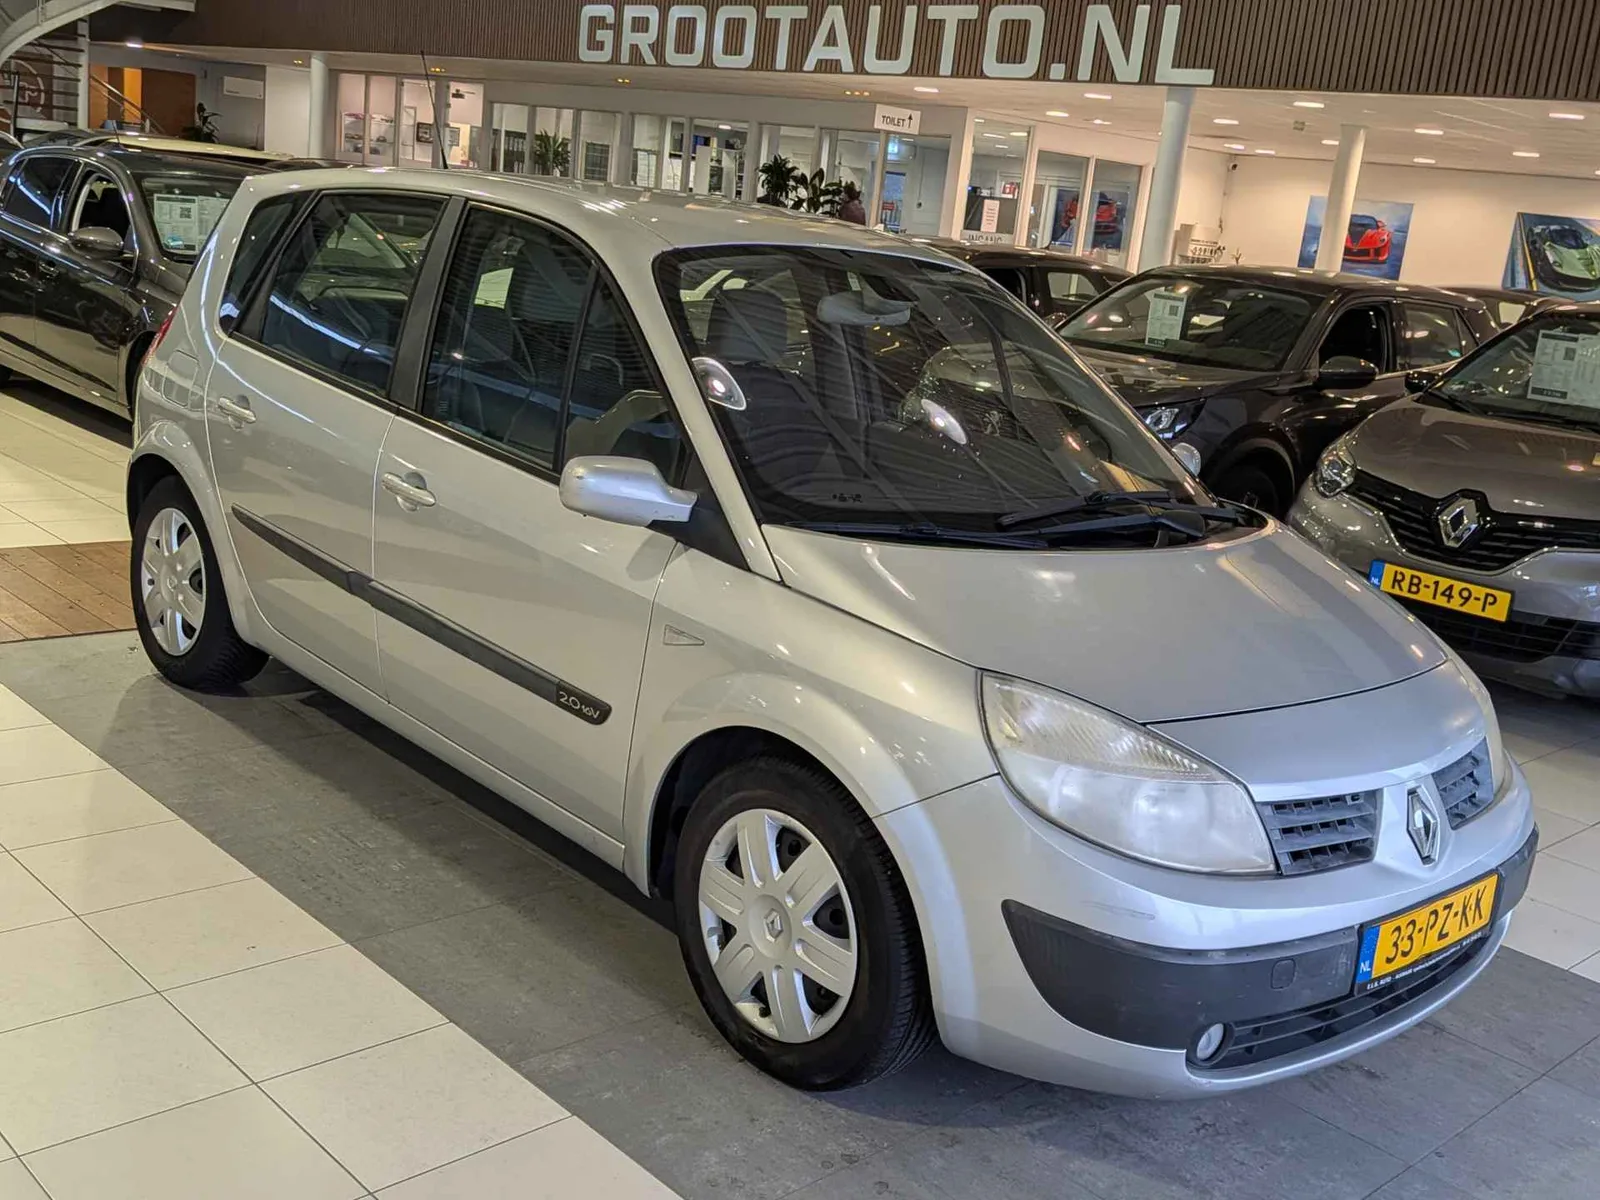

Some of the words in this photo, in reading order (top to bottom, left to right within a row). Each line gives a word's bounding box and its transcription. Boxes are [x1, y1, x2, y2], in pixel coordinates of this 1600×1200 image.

[578, 4, 1215, 86] GROOTAUTO.NL
[881, 114, 906, 127] TOILET
[1370, 576, 1380, 586] NL
[1391, 570, 1497, 612] RB-149-P
[1385, 885, 1487, 964] 33-PZ-KK
[1360, 961, 1371, 974] NL
